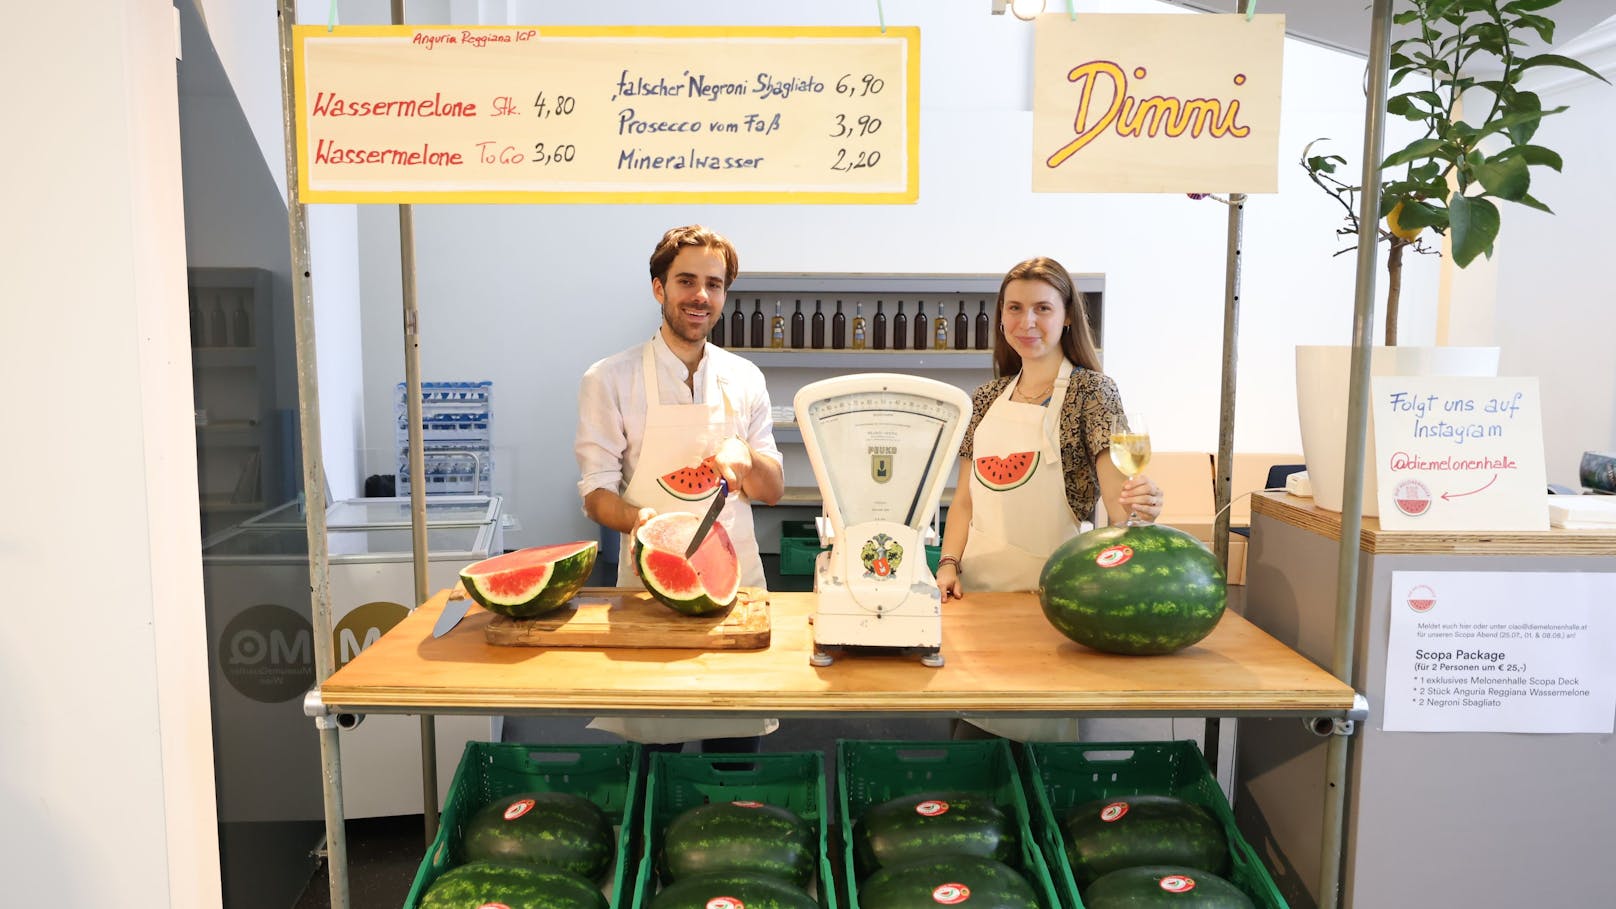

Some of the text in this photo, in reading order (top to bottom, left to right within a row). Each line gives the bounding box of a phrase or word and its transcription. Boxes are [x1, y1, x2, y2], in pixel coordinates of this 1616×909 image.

[412, 32, 457, 50] Anguria
[689, 75, 747, 101] Negroni
[836, 74, 885, 97] 6,90
[312, 91, 575, 119] Wassermelone Stk. 4,80
[1046, 60, 1250, 168] Dimmi
[619, 108, 882, 137] Prosecco vom Faß 3,90
[315, 139, 464, 166] Wassermelone
[532, 143, 575, 165] 3,60
[617, 148, 880, 171] Mineralwasser 2,20
[1390, 392, 1522, 418] Folgt uns auf
[1414, 419, 1502, 444] Instagram
[1390, 451, 1517, 471] @diemelonenhalle
[1418, 622, 1440, 630] Meldet
[340, 627, 381, 664] M
[1416, 650, 1505, 662] Scopa Package
[1507, 664, 1526, 672] 25,-)
[1428, 687, 1450, 695] Stück
[1453, 688, 1485, 697] Anguria
[1488, 688, 1526, 697] Reggiana
[1529, 688, 1590, 696] Wassermelone
[1471, 677, 1526, 685] Melonenhalle
[1529, 677, 1556, 687] Scopa
[1427, 699, 1460, 707] Negroni
[1462, 699, 1501, 707] Sbagliato
